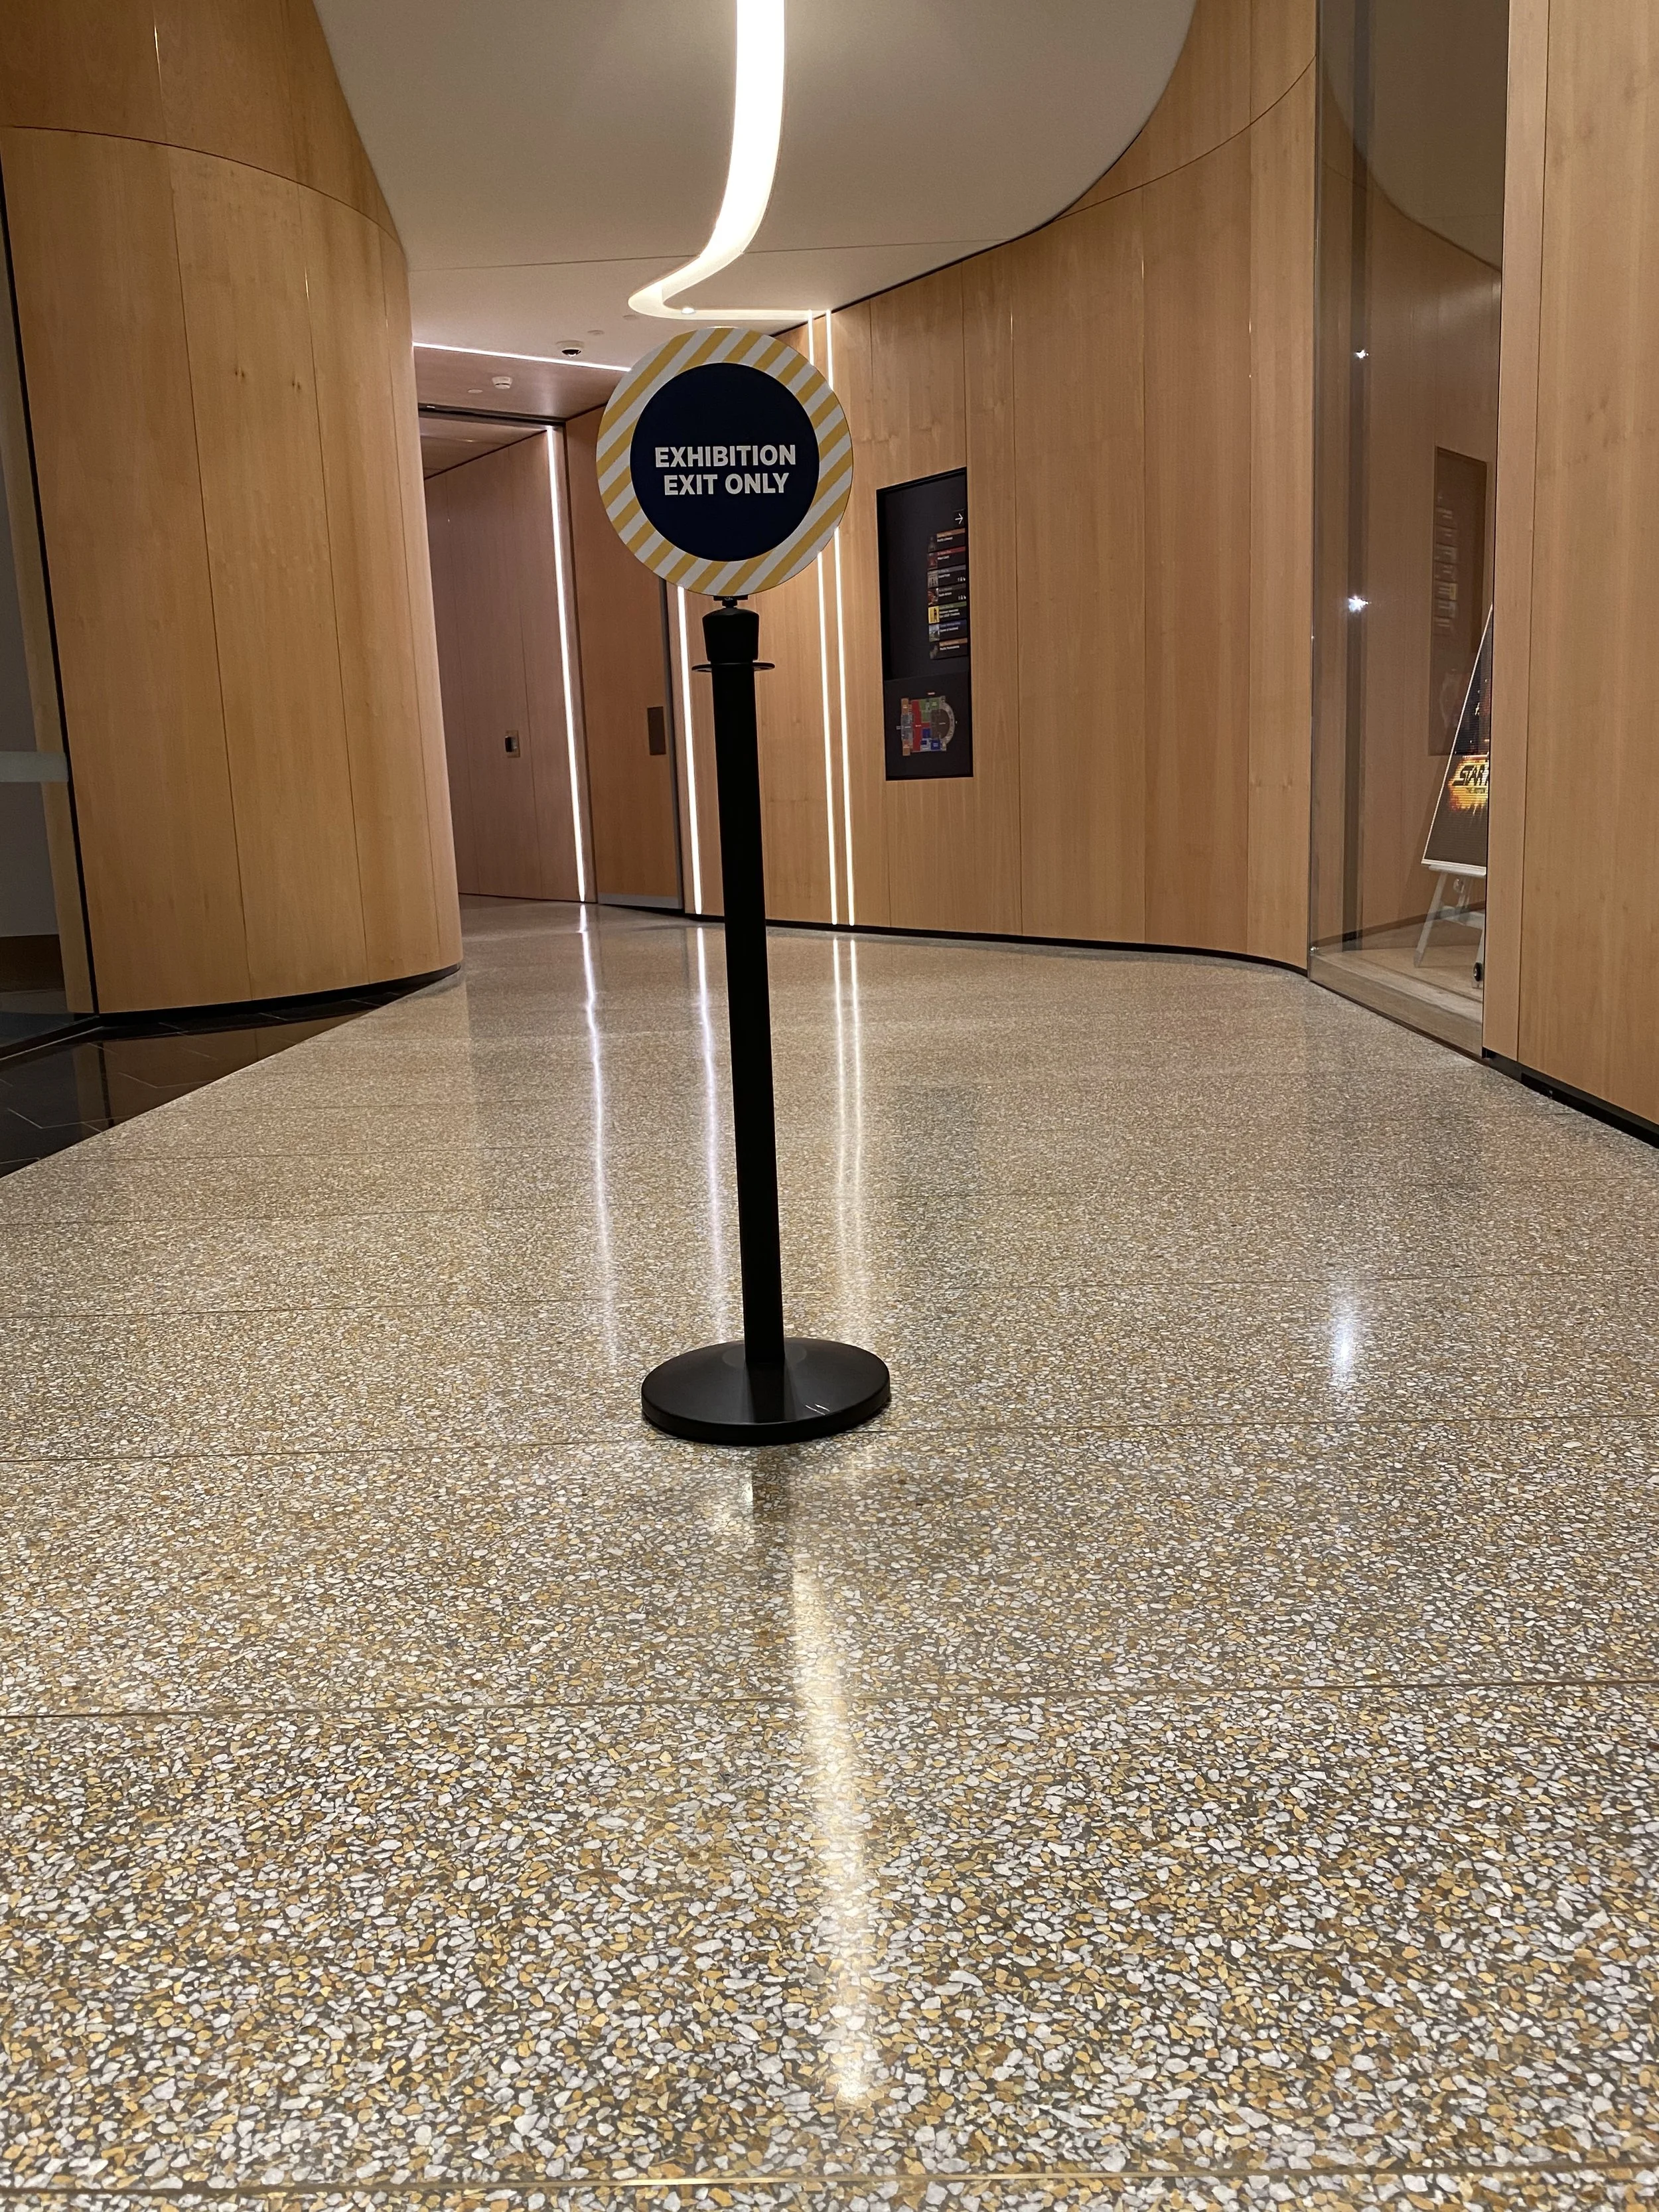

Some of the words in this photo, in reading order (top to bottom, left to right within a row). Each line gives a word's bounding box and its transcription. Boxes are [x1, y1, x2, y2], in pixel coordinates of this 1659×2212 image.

[655, 445, 796, 467] EXHIBITION
[664, 474, 717, 495] EXIT
[725, 473, 789, 494] ONLY
